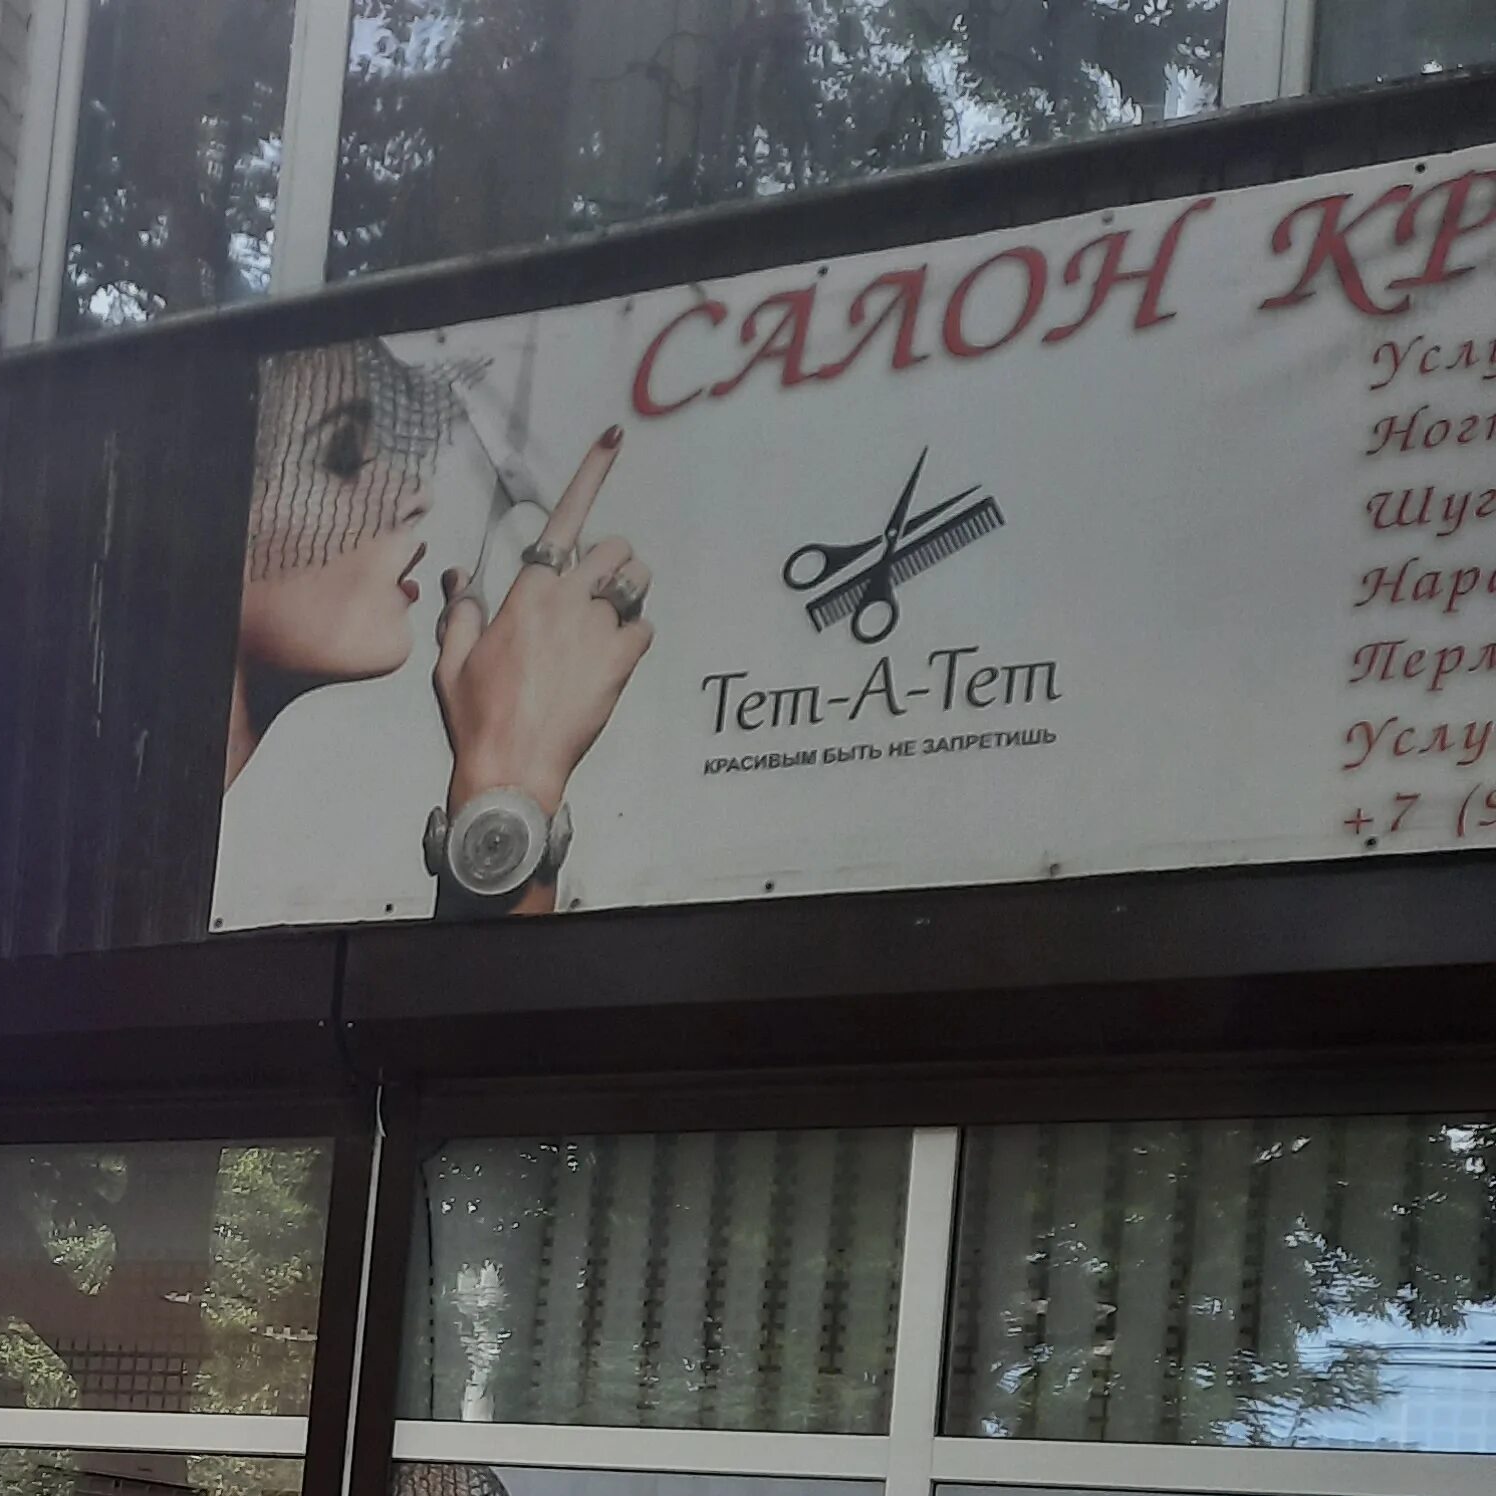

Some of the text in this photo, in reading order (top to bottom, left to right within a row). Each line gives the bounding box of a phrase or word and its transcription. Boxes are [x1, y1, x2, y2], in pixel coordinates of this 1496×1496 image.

[631, 197, 1214, 420] САЛОН
[1366, 405, 1496, 456] Ног
[1354, 556, 1496, 613] Нар
[703, 727, 1058, 777] КРАСИВЫМ БЫТЬ НЕ ЗАПРЕТИШЬ
